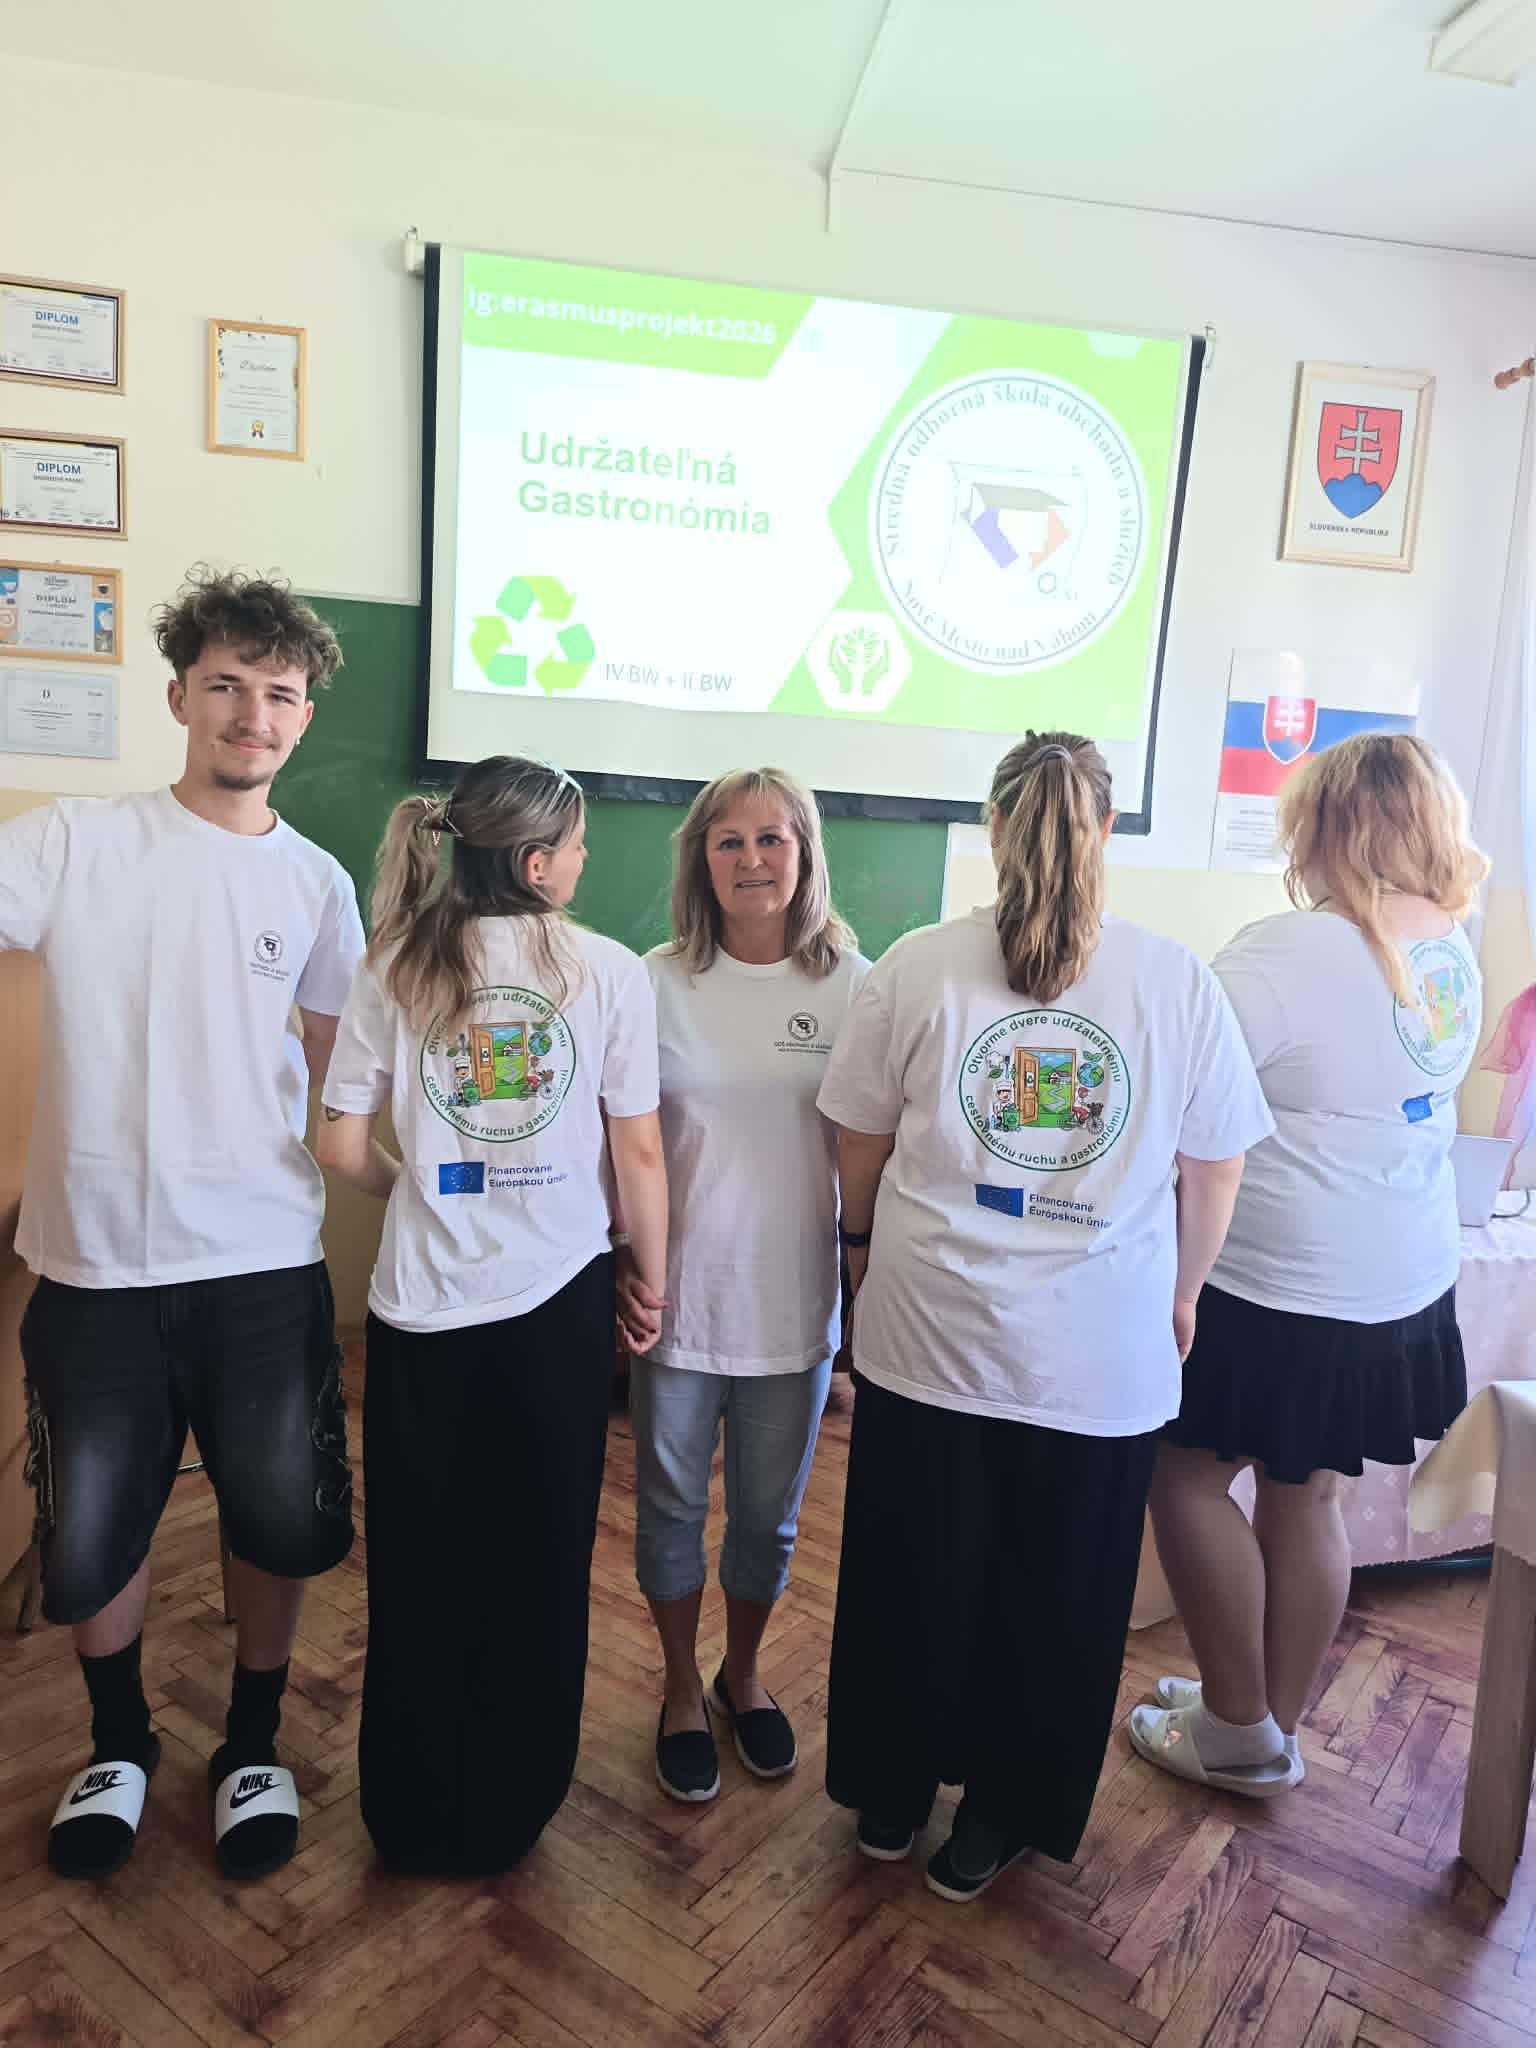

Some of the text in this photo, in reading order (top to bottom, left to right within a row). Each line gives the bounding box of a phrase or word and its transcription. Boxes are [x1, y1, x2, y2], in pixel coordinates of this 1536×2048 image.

[35, 311, 79, 325] DIPLOM
[520, 431, 738, 485] Udržateľná
[36, 462, 81, 475] DIPLOM
[518, 480, 771, 535] Gastronómia
[968, 1025, 1008, 1075] Otvorme
[1009, 1015, 1048, 1032] dvere
[480, 1126, 515, 1137] ruchu
[1017, 1151, 1057, 1165] ruchu
[1060, 1155, 1068, 1164] a
[1029, 1193, 1095, 1213] Financované
[81, 1769, 121, 1790] NIKE
[237, 1772, 273, 1793] NIKE
